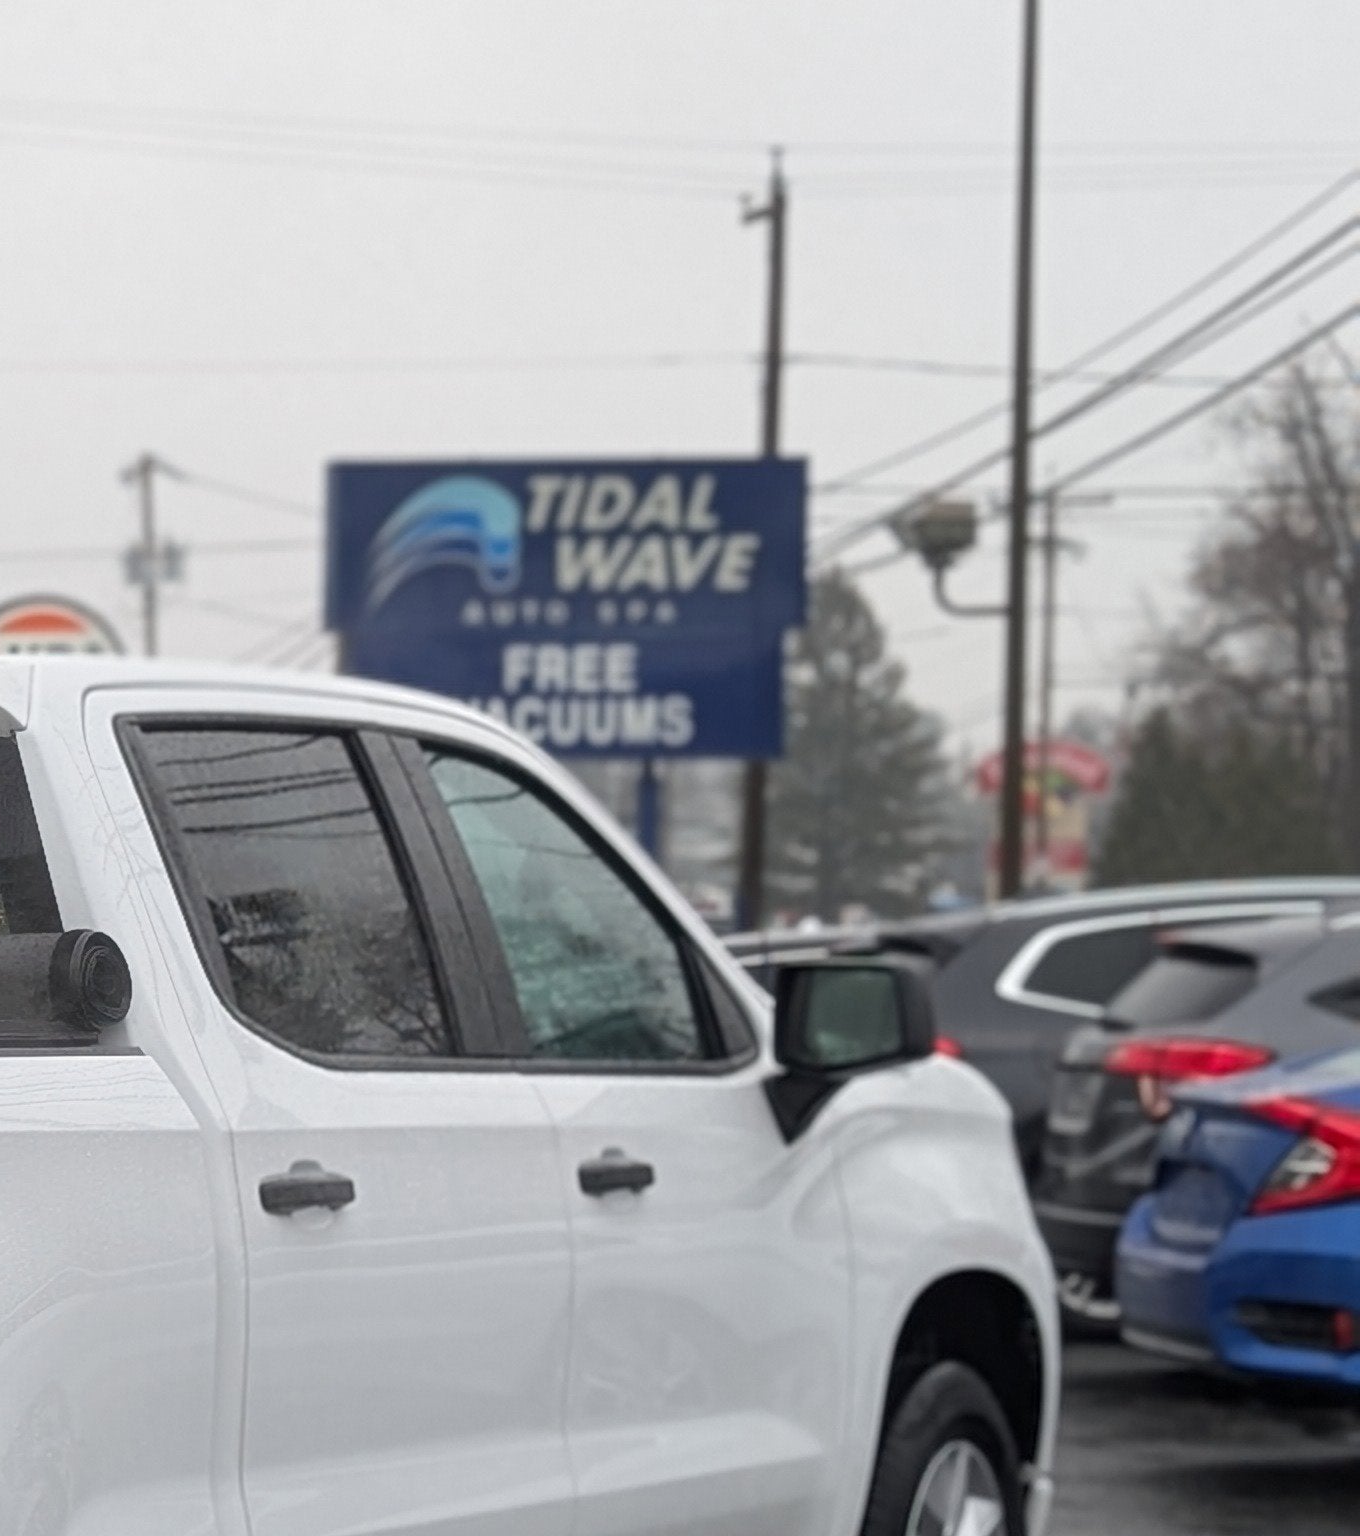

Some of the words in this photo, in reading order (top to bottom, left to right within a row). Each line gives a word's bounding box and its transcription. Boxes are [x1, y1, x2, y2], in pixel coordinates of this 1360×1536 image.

[526, 474, 720, 533] TIDAL
[554, 534, 760, 592] WAVE
[502, 642, 638, 695] FREE
